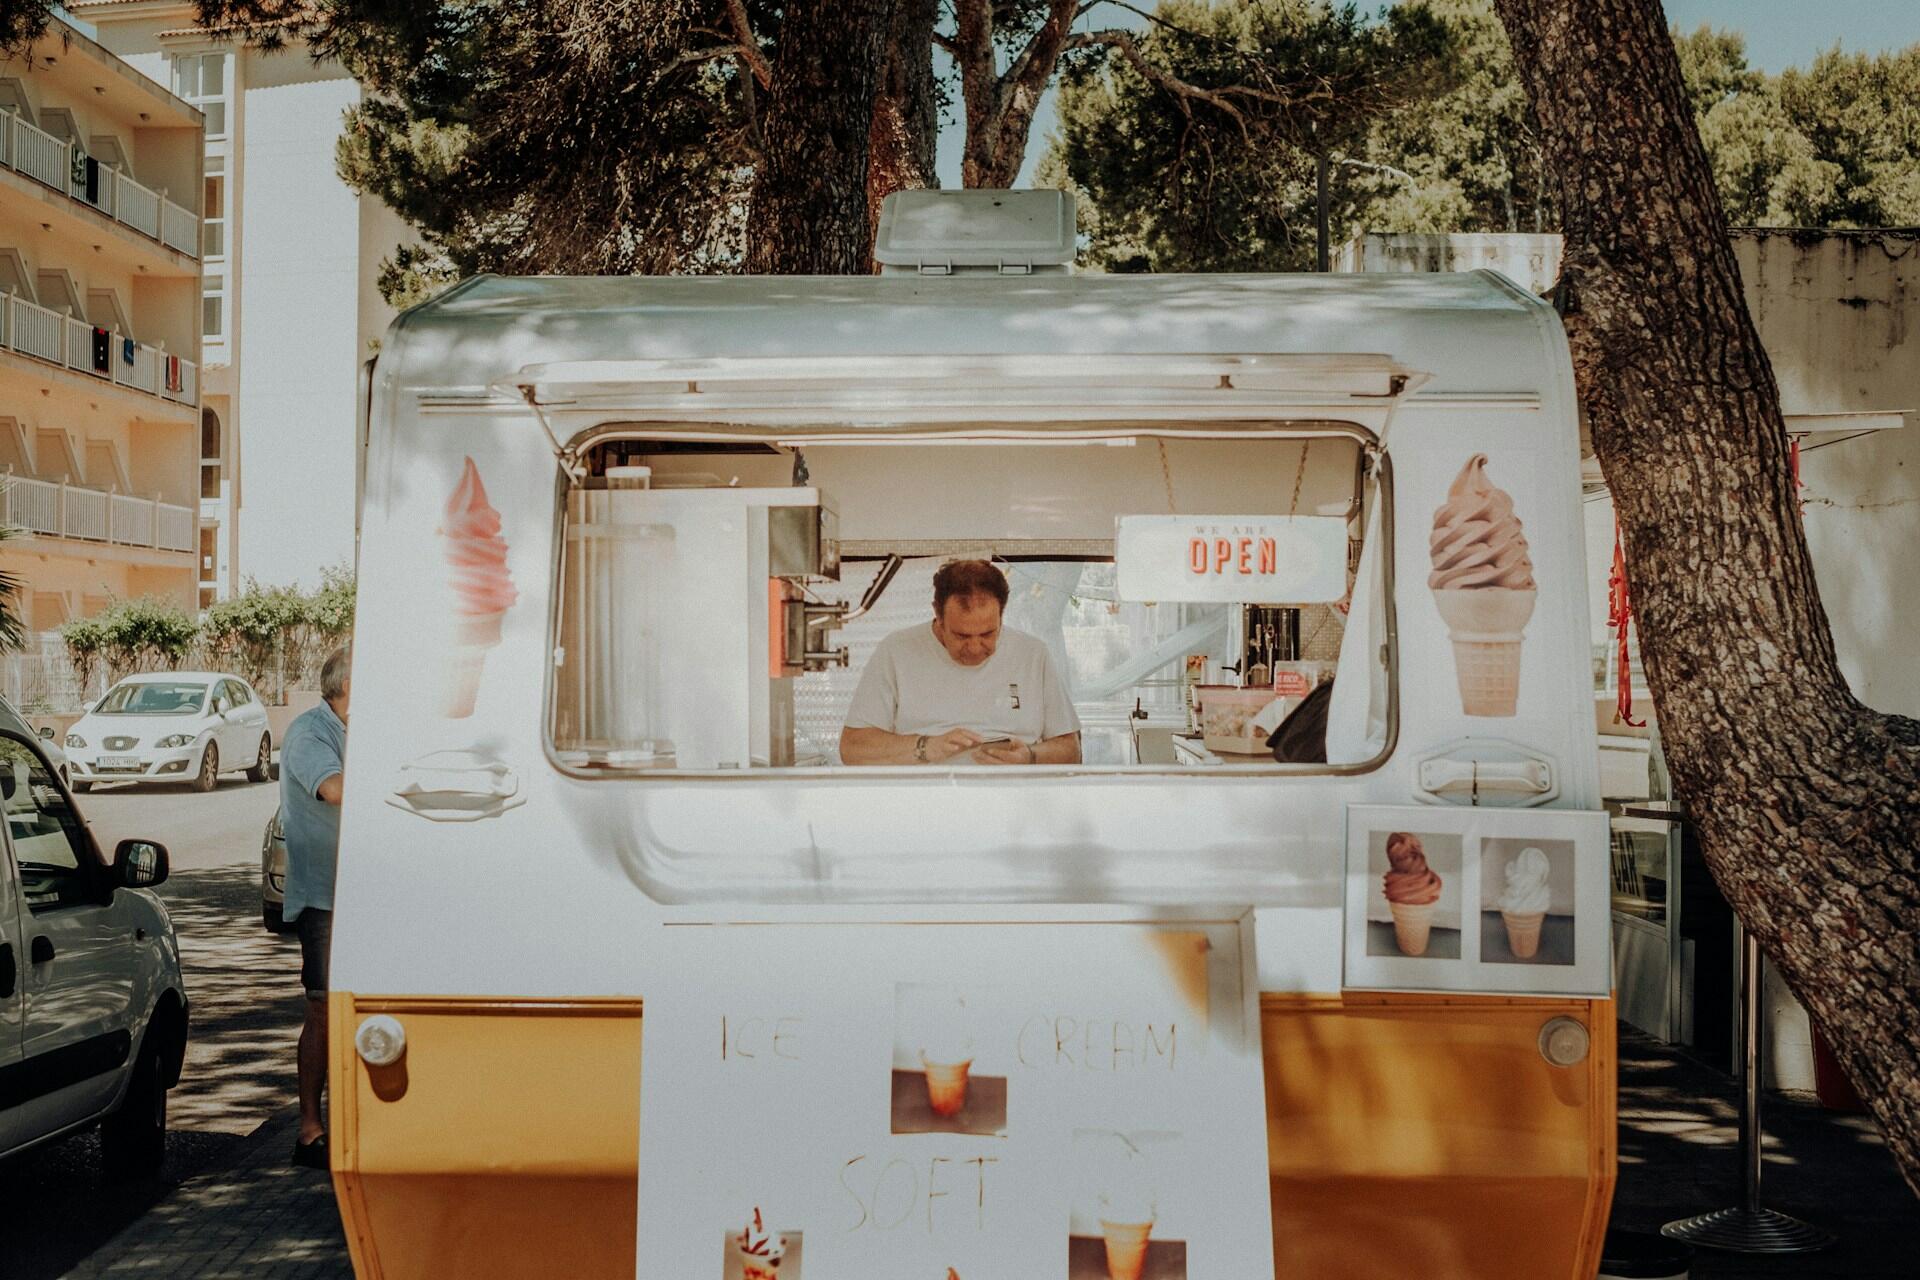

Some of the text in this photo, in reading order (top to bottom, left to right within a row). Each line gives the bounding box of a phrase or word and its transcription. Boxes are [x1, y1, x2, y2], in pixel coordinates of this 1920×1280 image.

[1195, 526, 1267, 535] WE ARE
[1188, 536, 1277, 576] OPEN
[722, 1012, 1178, 1072] ICE CREAM
[839, 1153, 999, 1233] SOFT
